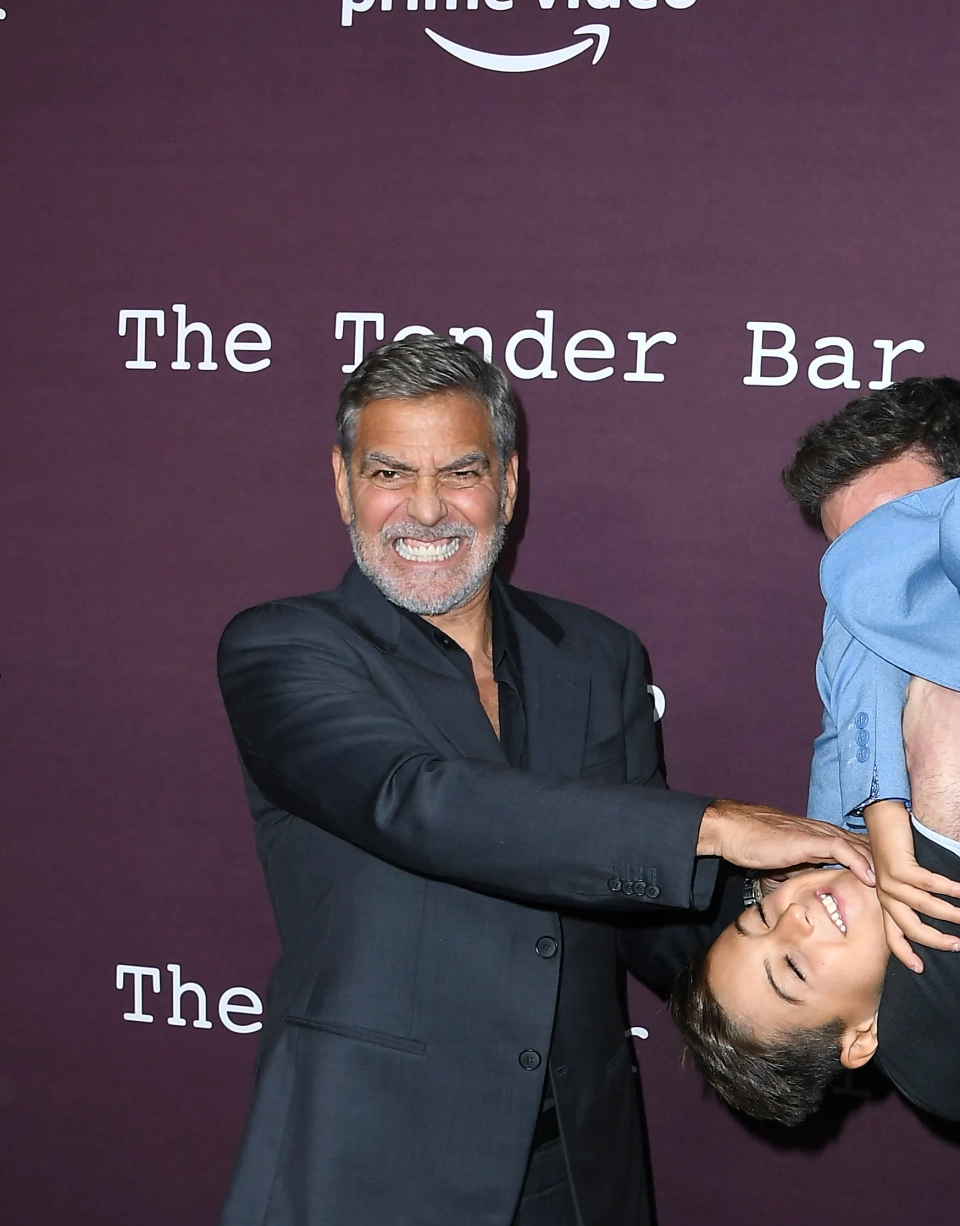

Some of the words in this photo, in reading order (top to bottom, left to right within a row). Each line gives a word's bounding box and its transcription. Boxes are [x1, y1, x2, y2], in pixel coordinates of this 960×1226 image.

[118, 304, 272, 373] The
[742, 321, 925, 391] Bar
[116, 964, 263, 1034] The
